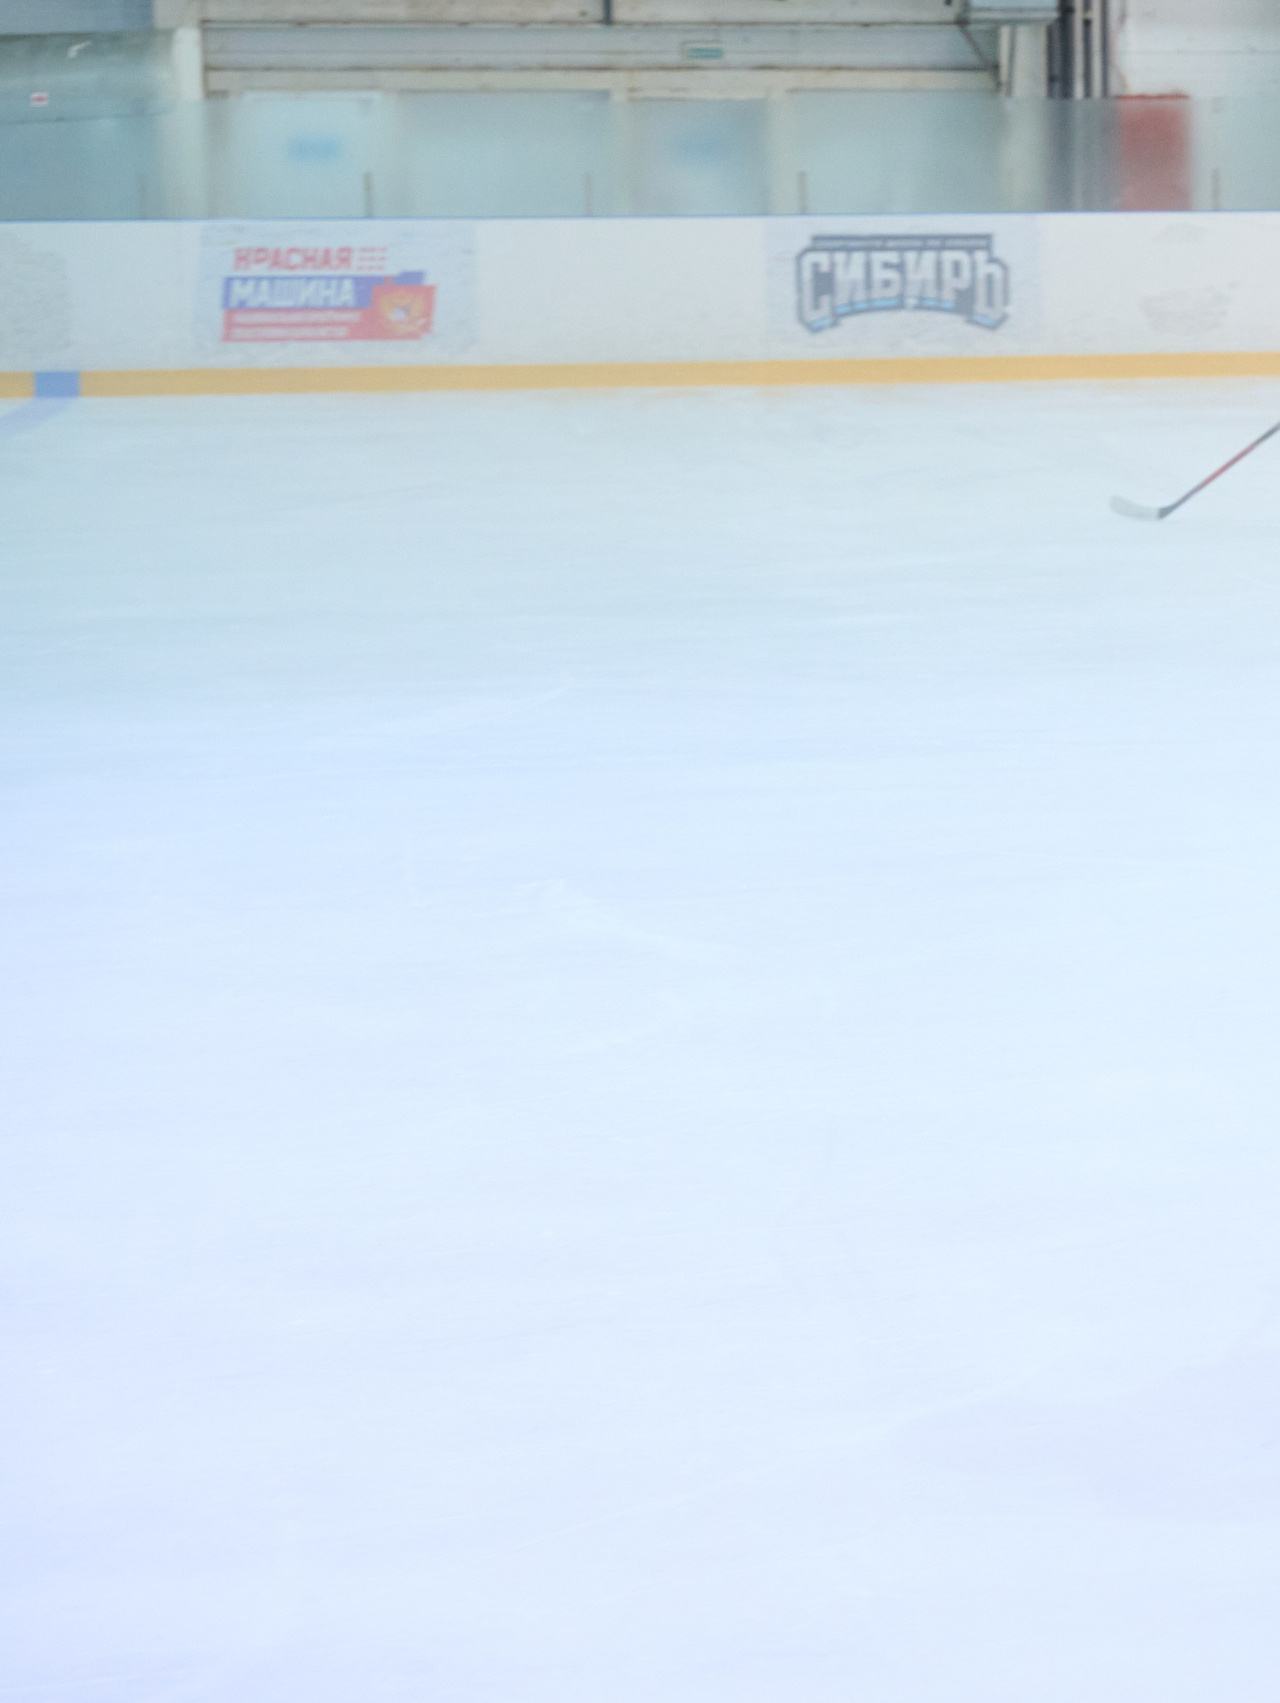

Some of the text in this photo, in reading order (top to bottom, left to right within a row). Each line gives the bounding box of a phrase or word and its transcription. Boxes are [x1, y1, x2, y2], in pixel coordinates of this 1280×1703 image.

[232, 246, 353, 270] КРАСНАЯ
[229, 277, 356, 308] МАШИНА
[802, 250, 1006, 323] СИБИРЬ
